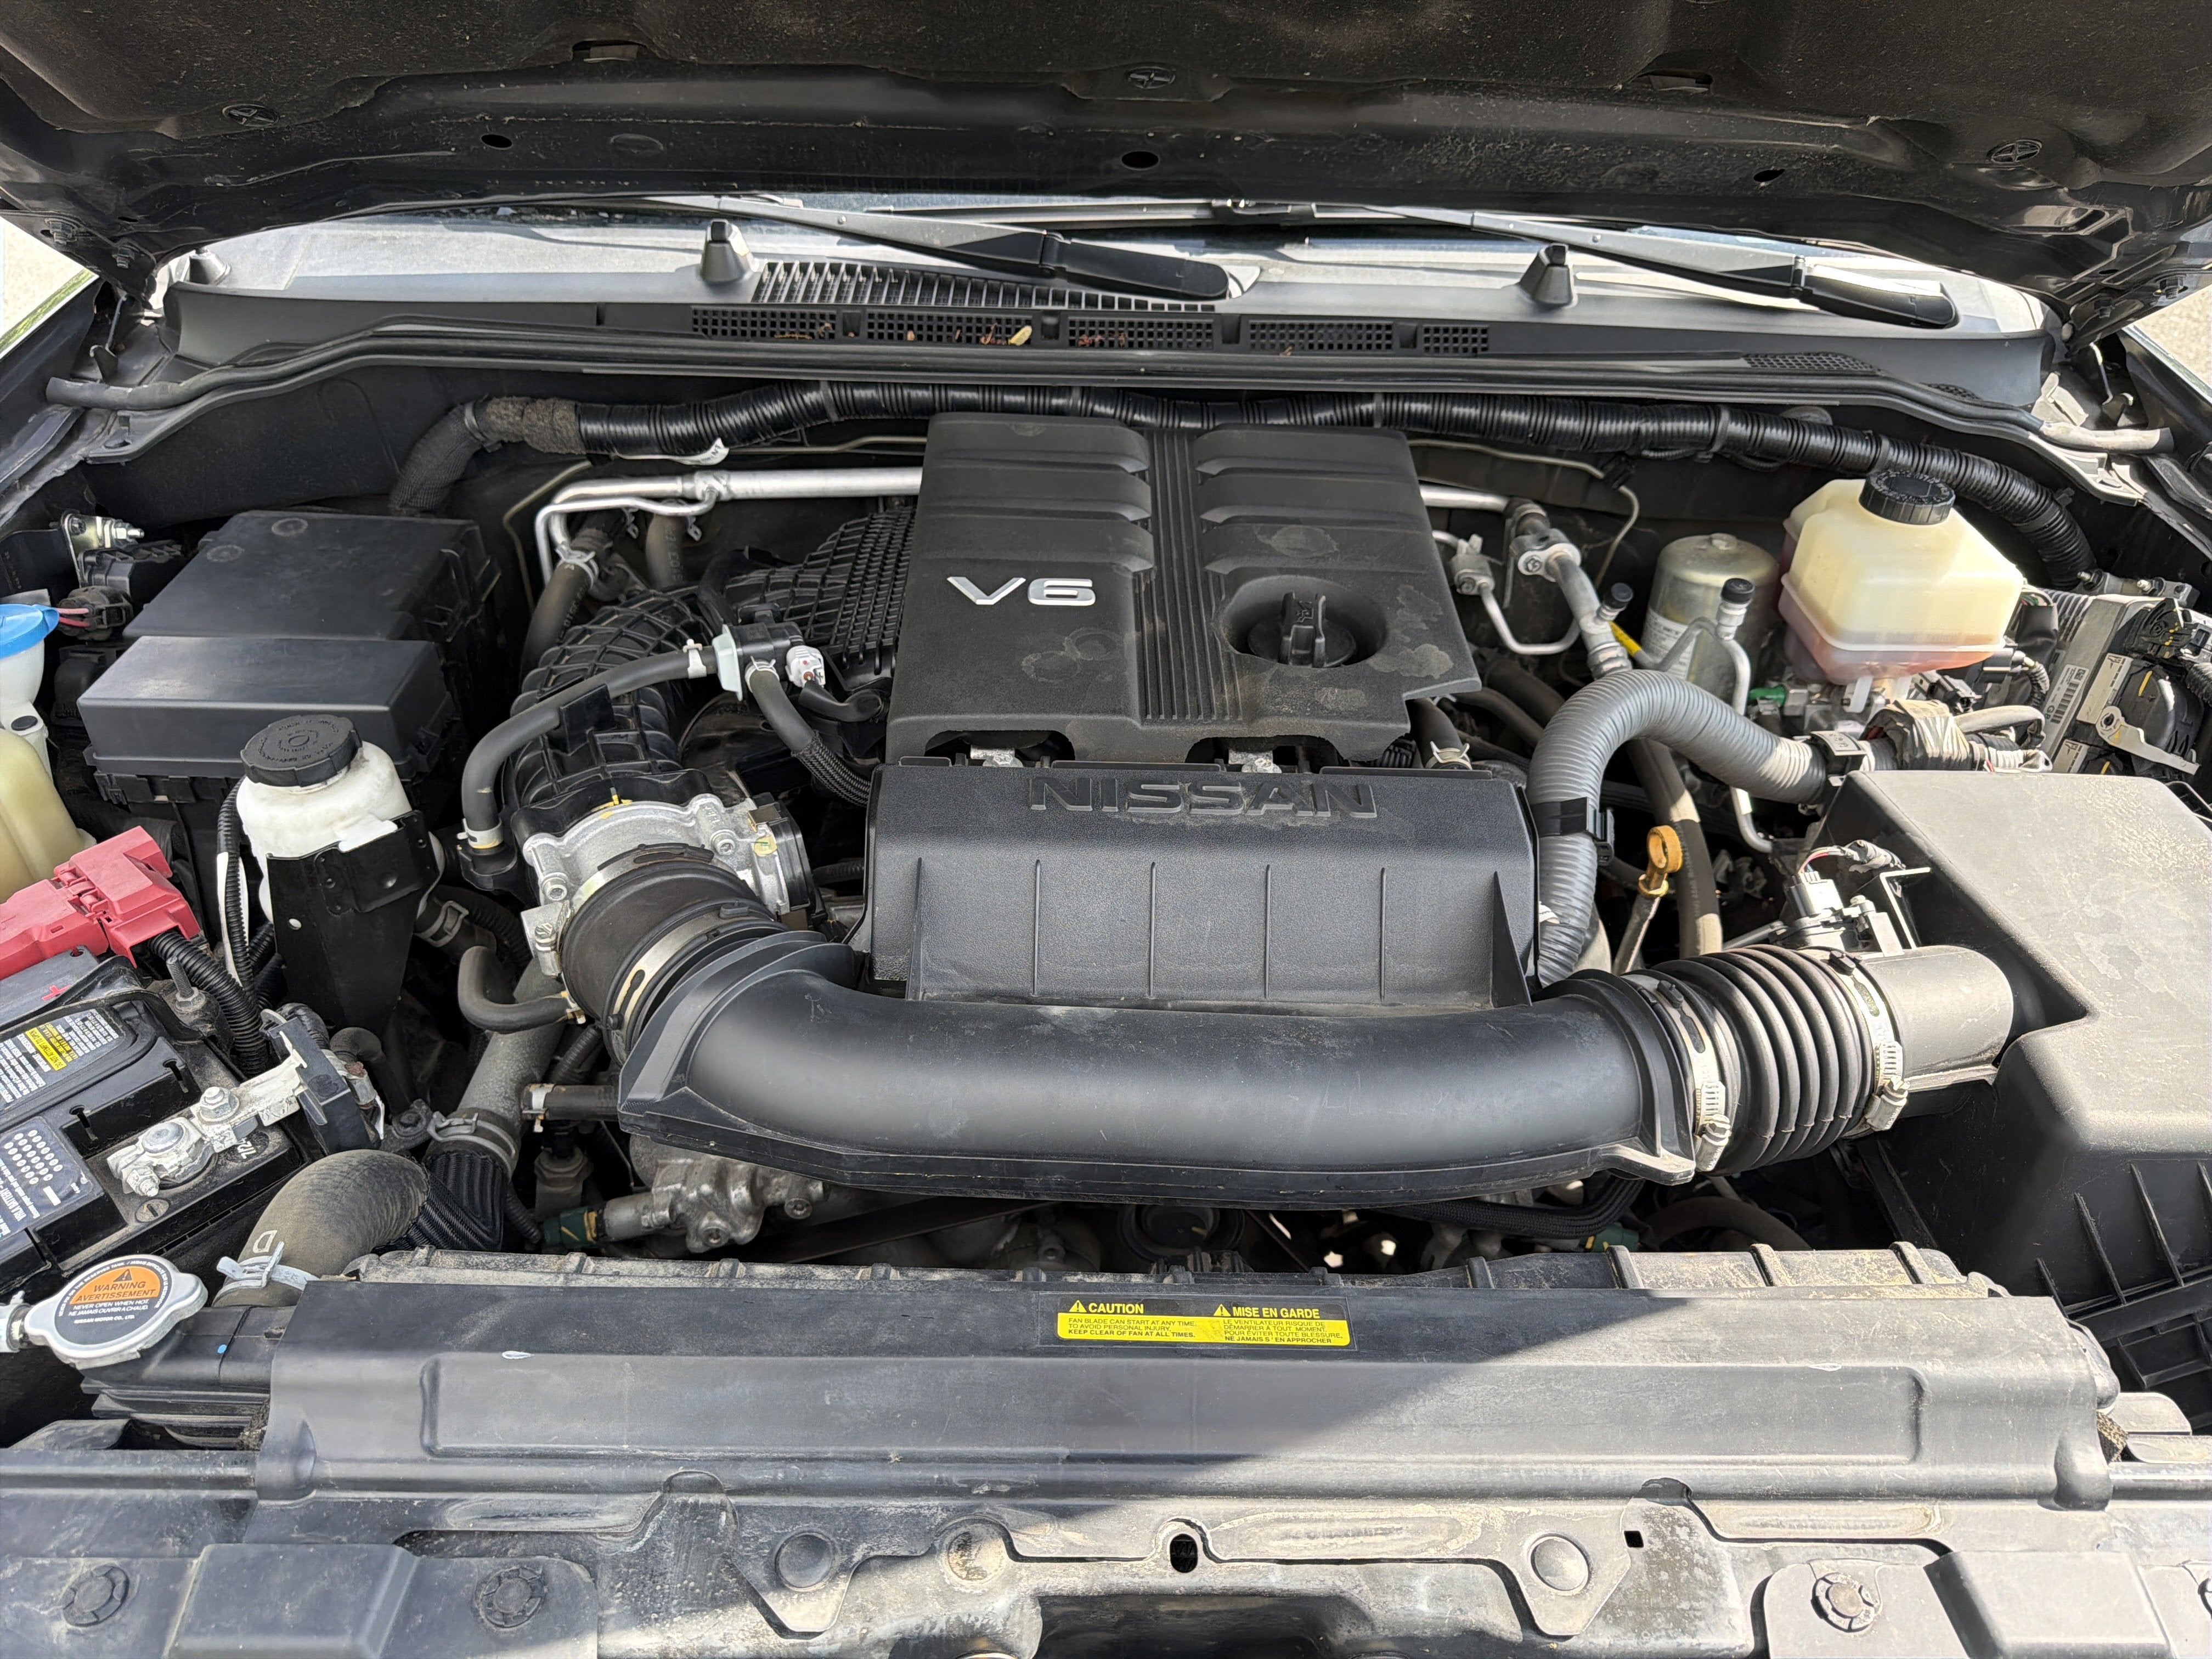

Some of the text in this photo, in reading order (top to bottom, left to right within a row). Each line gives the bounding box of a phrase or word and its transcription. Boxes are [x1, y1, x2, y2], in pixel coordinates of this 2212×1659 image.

[947, 577, 1096, 606] V6
[1030, 776, 1378, 818] NISSAN
[94, 1282, 146, 1292] WARNING
[76, 1289, 156, 1302] AVERTISSEMENT
[1088, 1303, 1144, 1314] CAUTION
[1232, 1306, 1320, 1318] MISE EN GARDE
